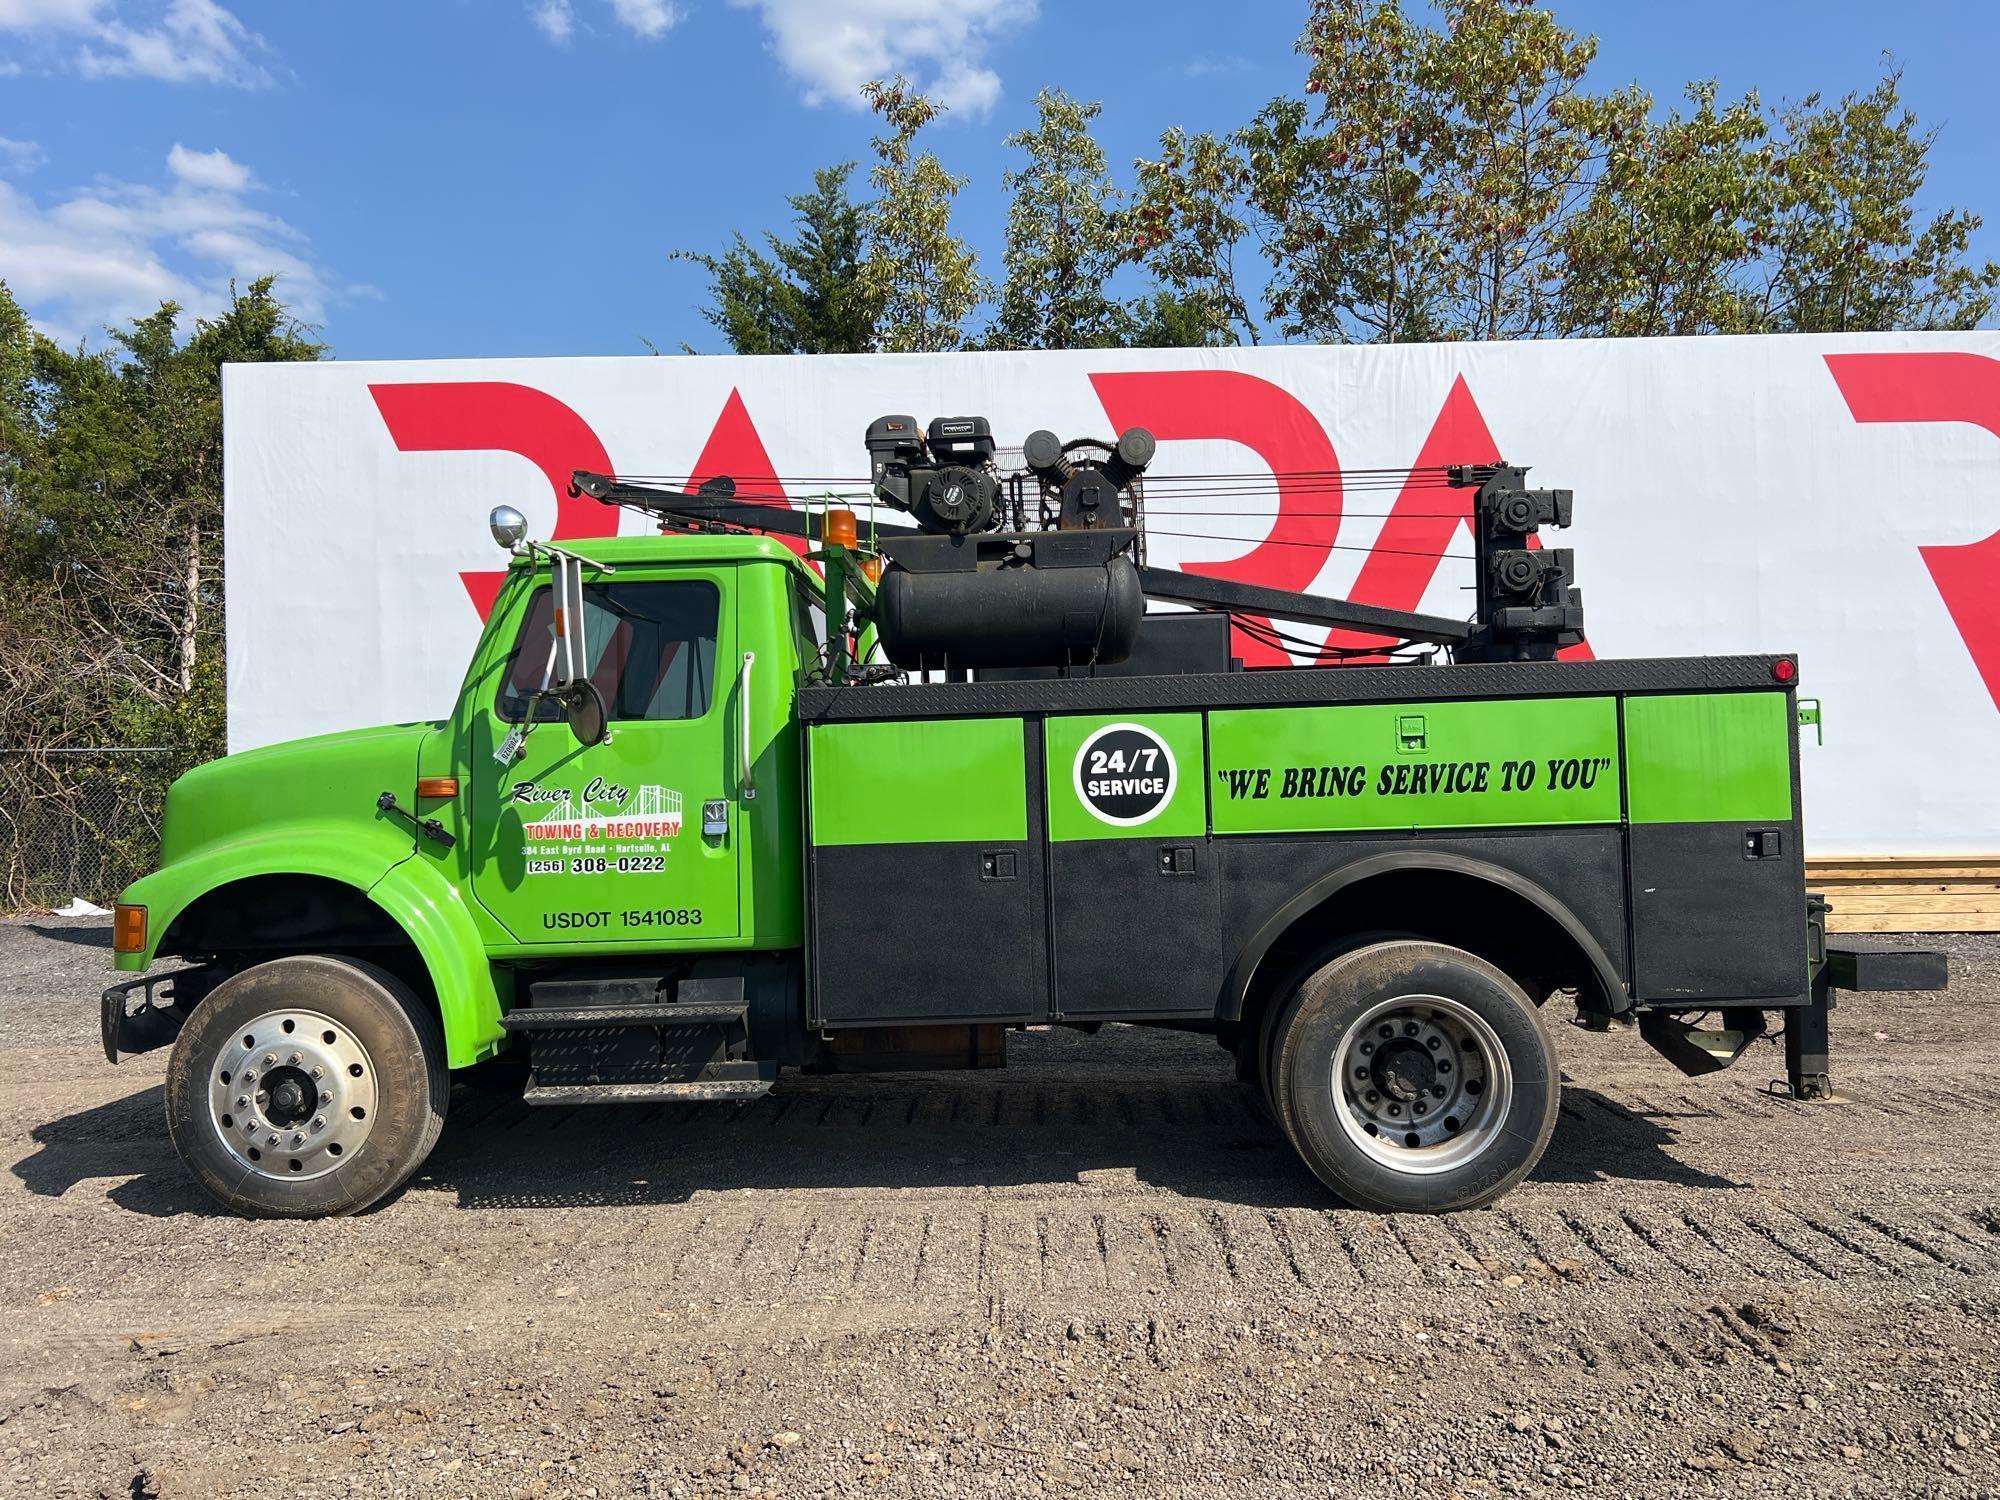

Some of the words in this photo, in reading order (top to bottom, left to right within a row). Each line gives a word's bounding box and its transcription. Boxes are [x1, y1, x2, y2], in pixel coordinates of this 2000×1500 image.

[1090, 748, 1159, 775] 24/7
[1087, 777, 1164, 797] SERVICE
[1280, 765, 1367, 799] BRING
[1376, 761, 1490, 796] SERVICE
[1500, 760, 1536, 792] TO
[512, 781, 572, 804] River
[583, 776, 630, 806] City
[526, 823, 582, 840] TOWING
[589, 823, 600, 838] &
[606, 821, 680, 839] RECOVERY
[540, 844, 560, 855] East
[562, 843, 582, 856] Byrd
[584, 843, 606, 854] Road
[660, 843, 672, 852] AL
[528, 860, 565, 873] (256)
[572, 856, 665, 873] 308-0222
[543, 911, 612, 929] USDOT
[619, 909, 703, 927] 1541083
